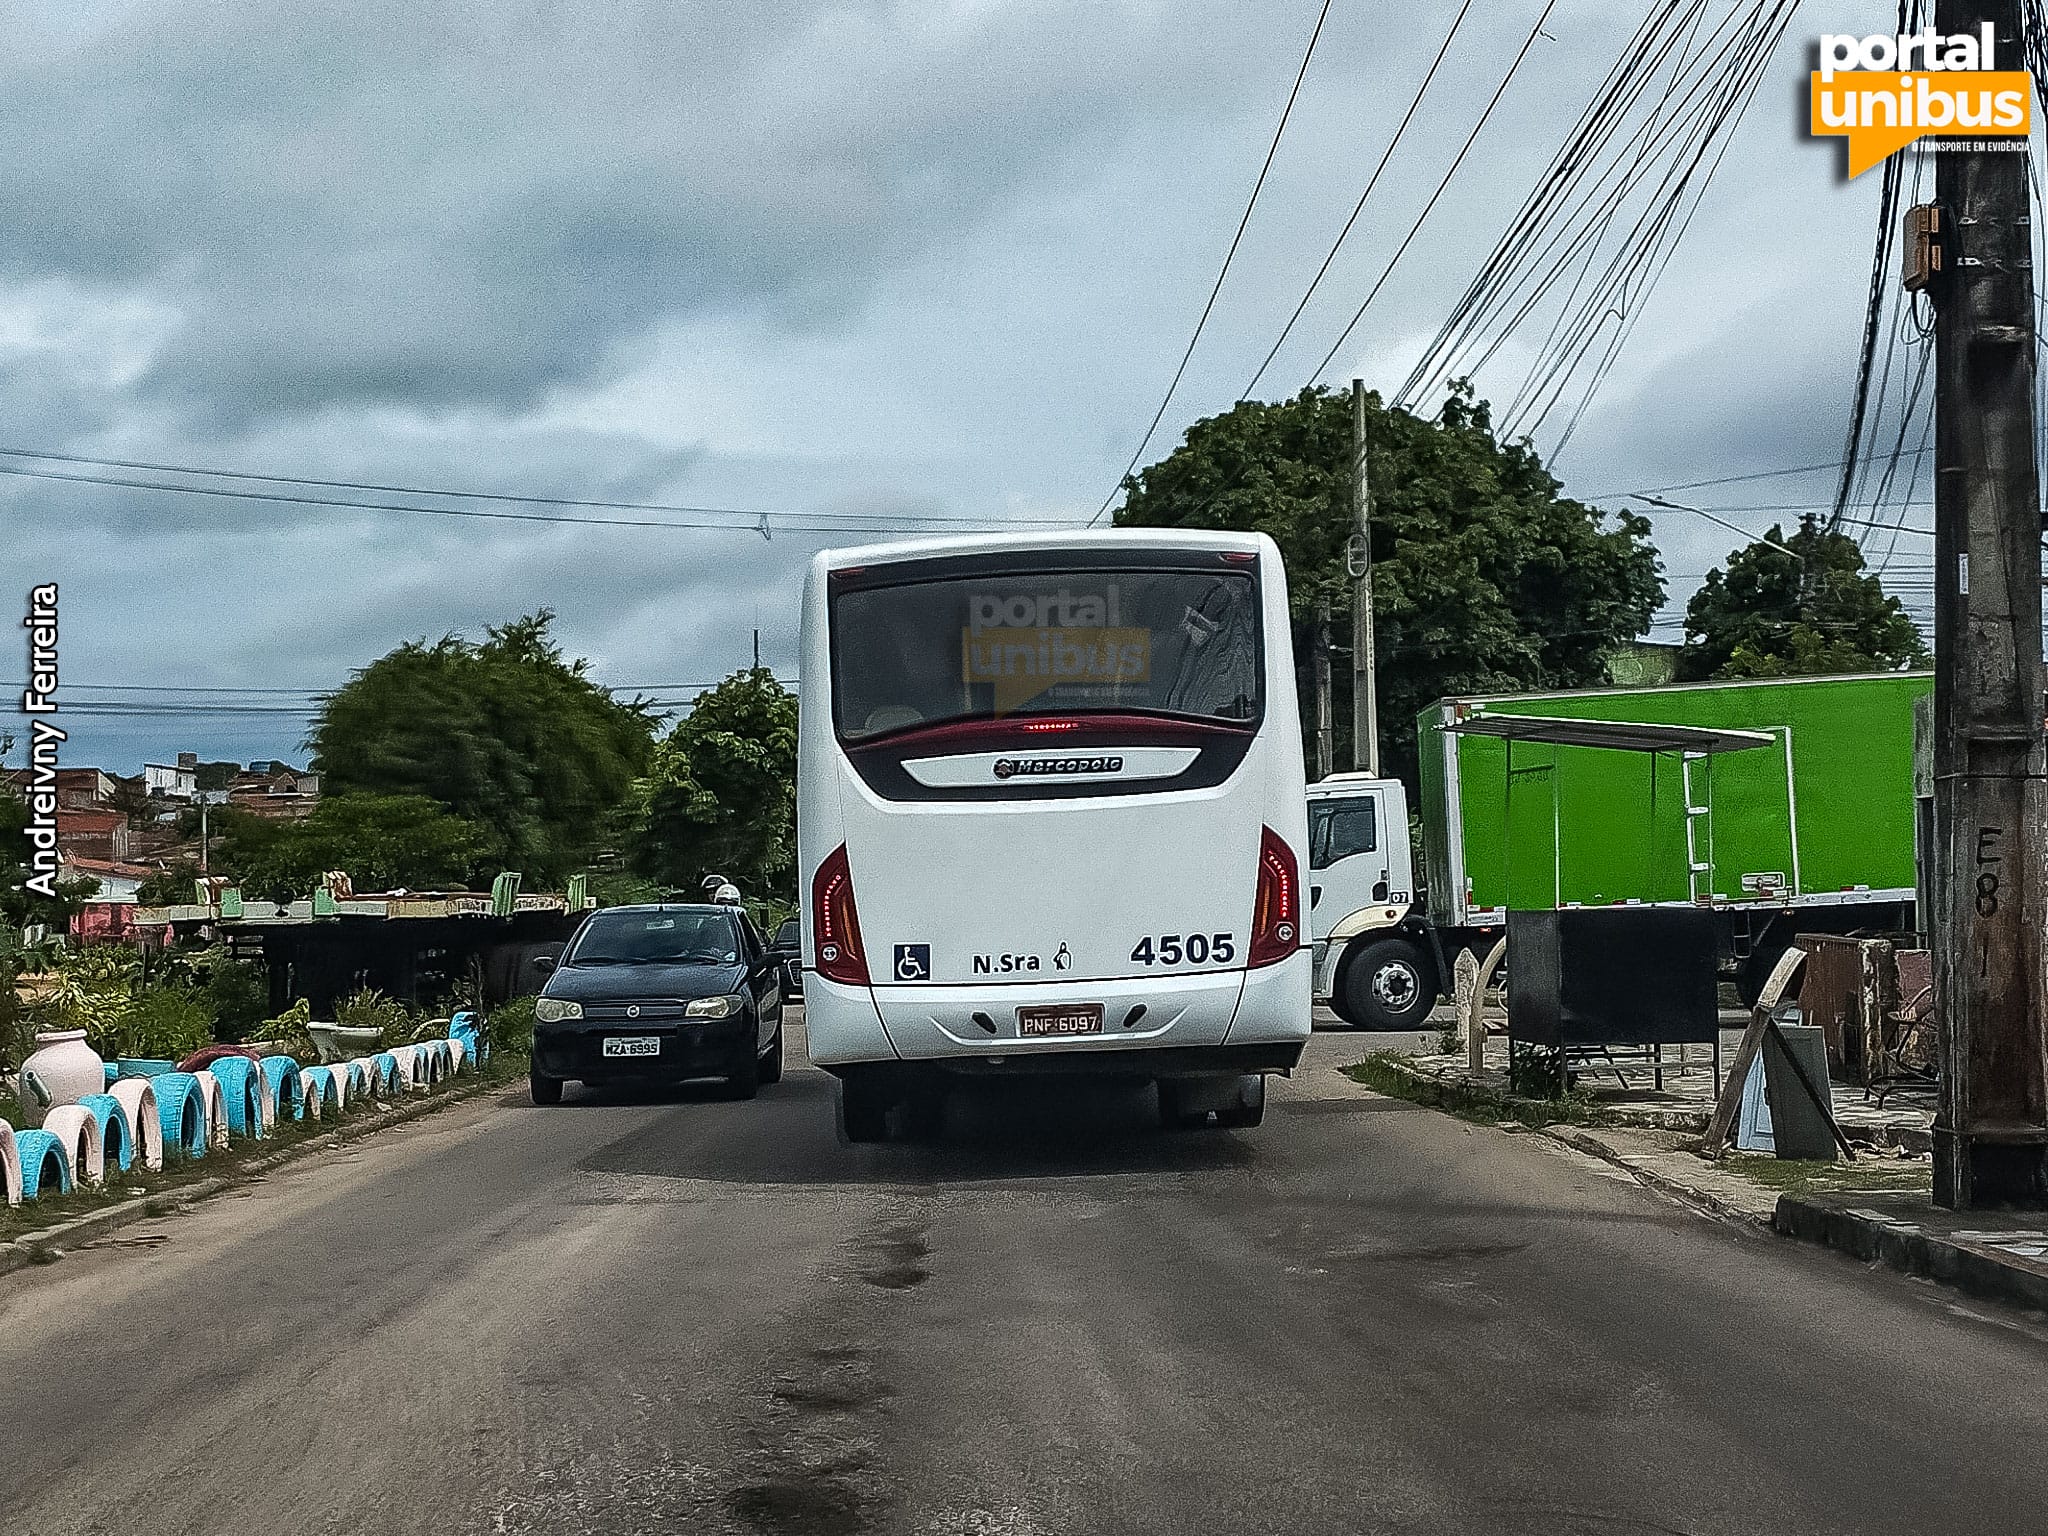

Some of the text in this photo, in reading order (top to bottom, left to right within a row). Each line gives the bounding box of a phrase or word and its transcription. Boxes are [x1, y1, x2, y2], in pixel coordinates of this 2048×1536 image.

[1017, 757, 1121, 773] Marcopolo
[1392, 892, 1407, 903] 07
[1130, 932, 1236, 967] 4505
